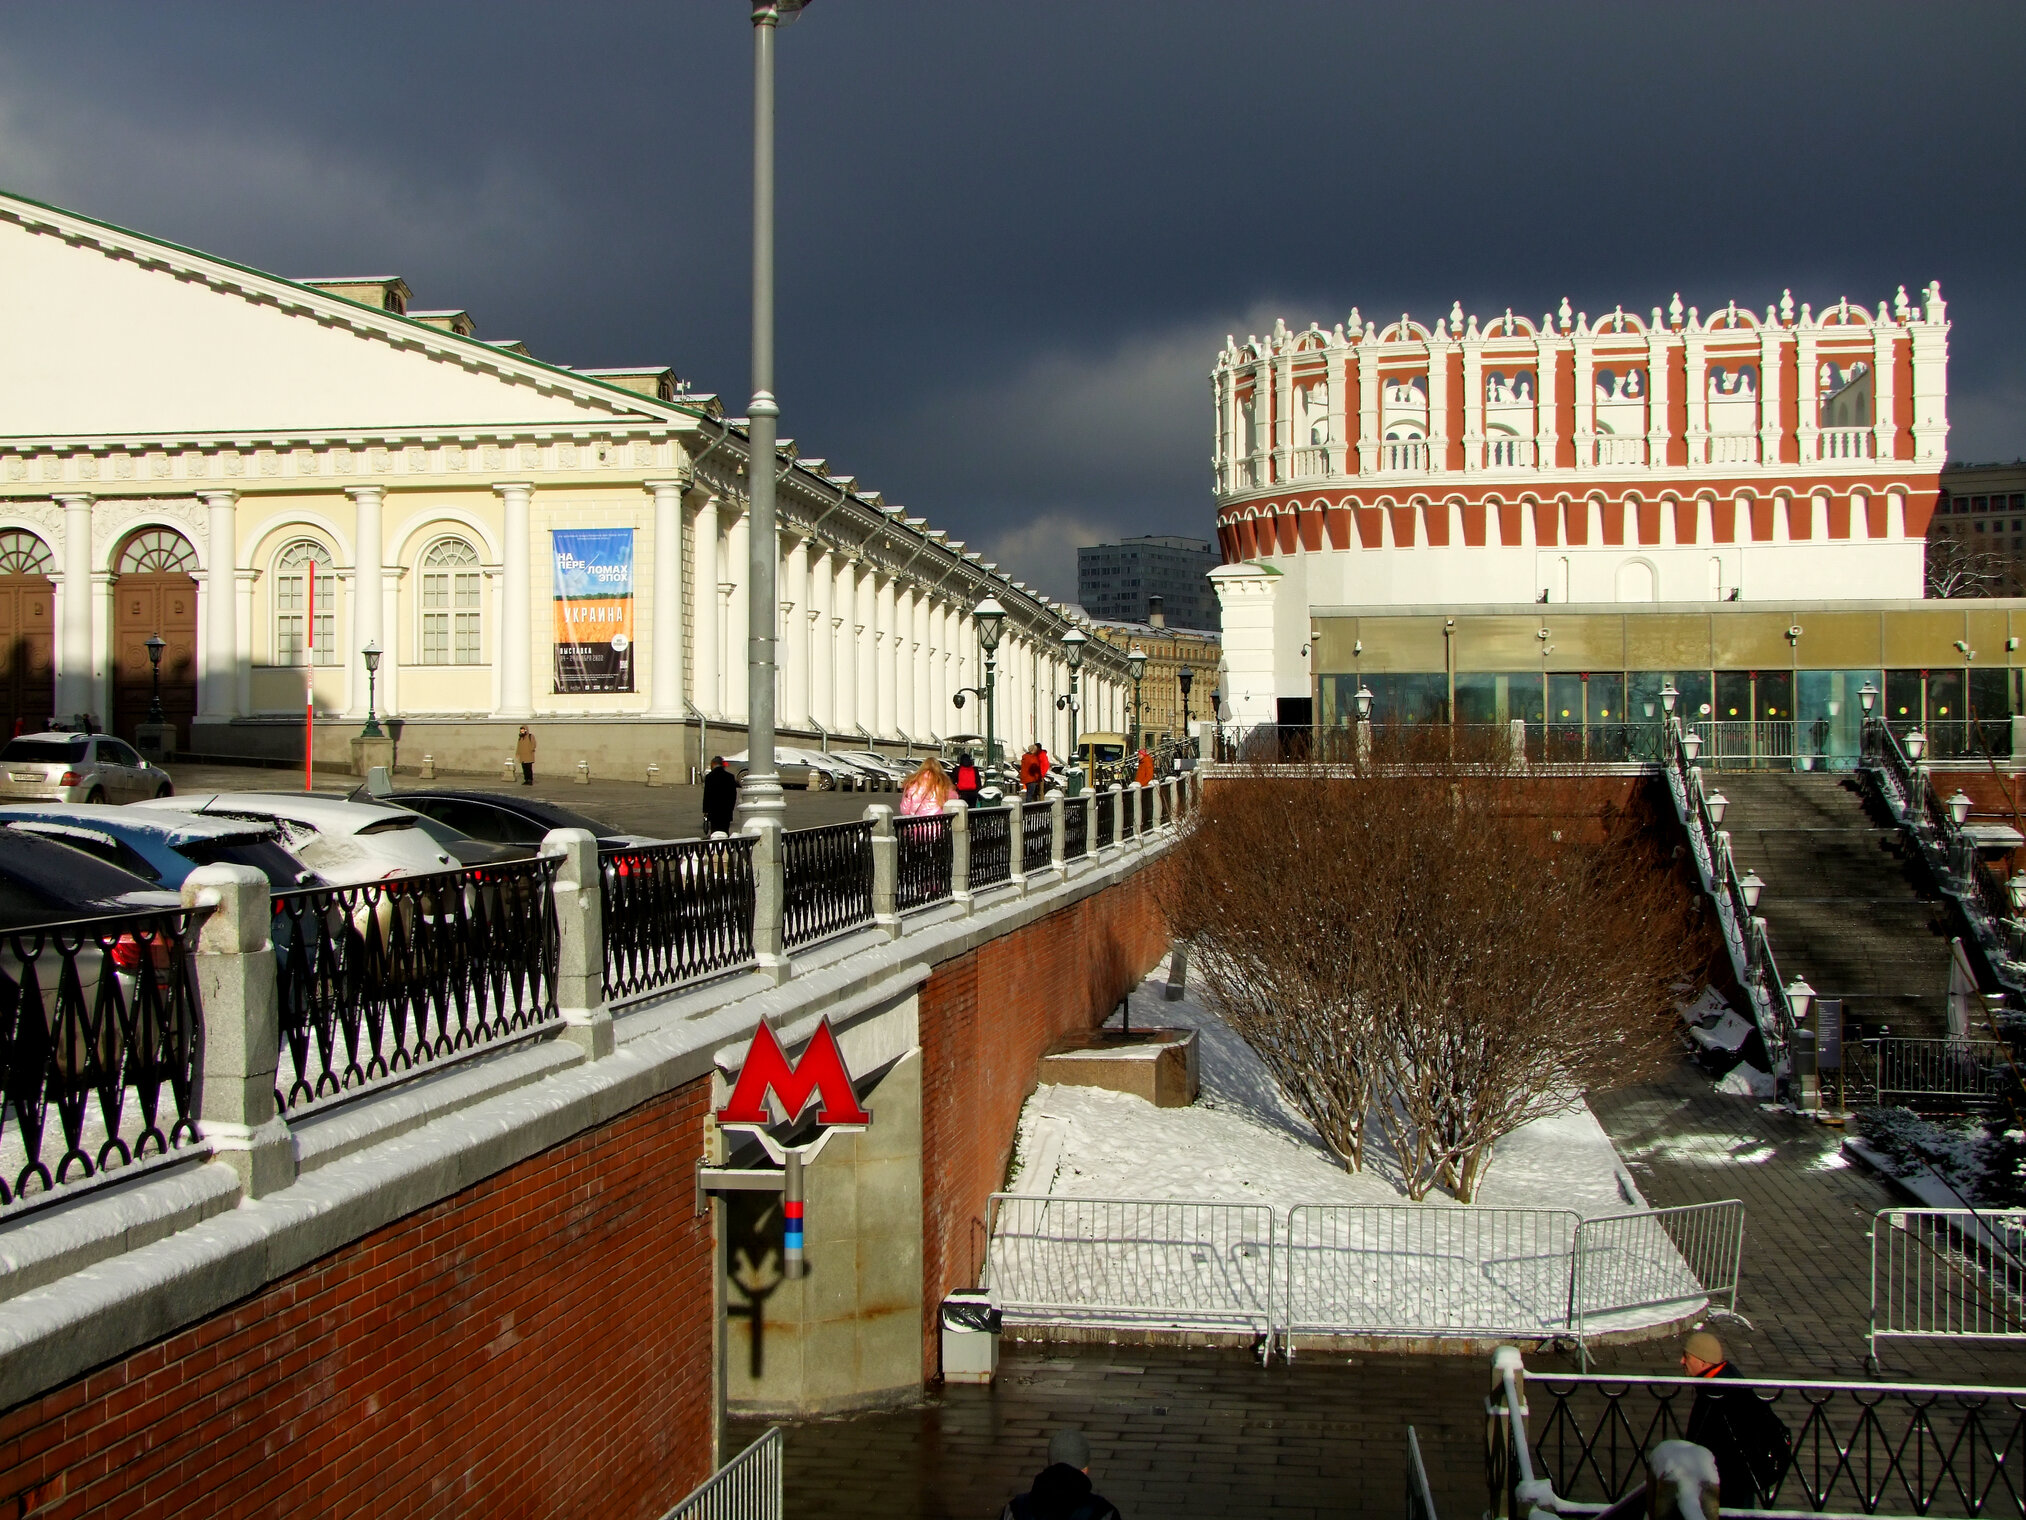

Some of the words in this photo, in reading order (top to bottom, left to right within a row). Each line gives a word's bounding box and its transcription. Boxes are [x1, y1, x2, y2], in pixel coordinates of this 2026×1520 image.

[558, 552, 573, 561] НА
[558, 561, 585, 569] ПЕРЕ
[587, 565, 628, 574] ЛОМАХ
[599, 573, 628, 582] ЭПОХ
[564, 607, 623, 622] УКРАИНА
[716, 1013, 873, 1126] М
